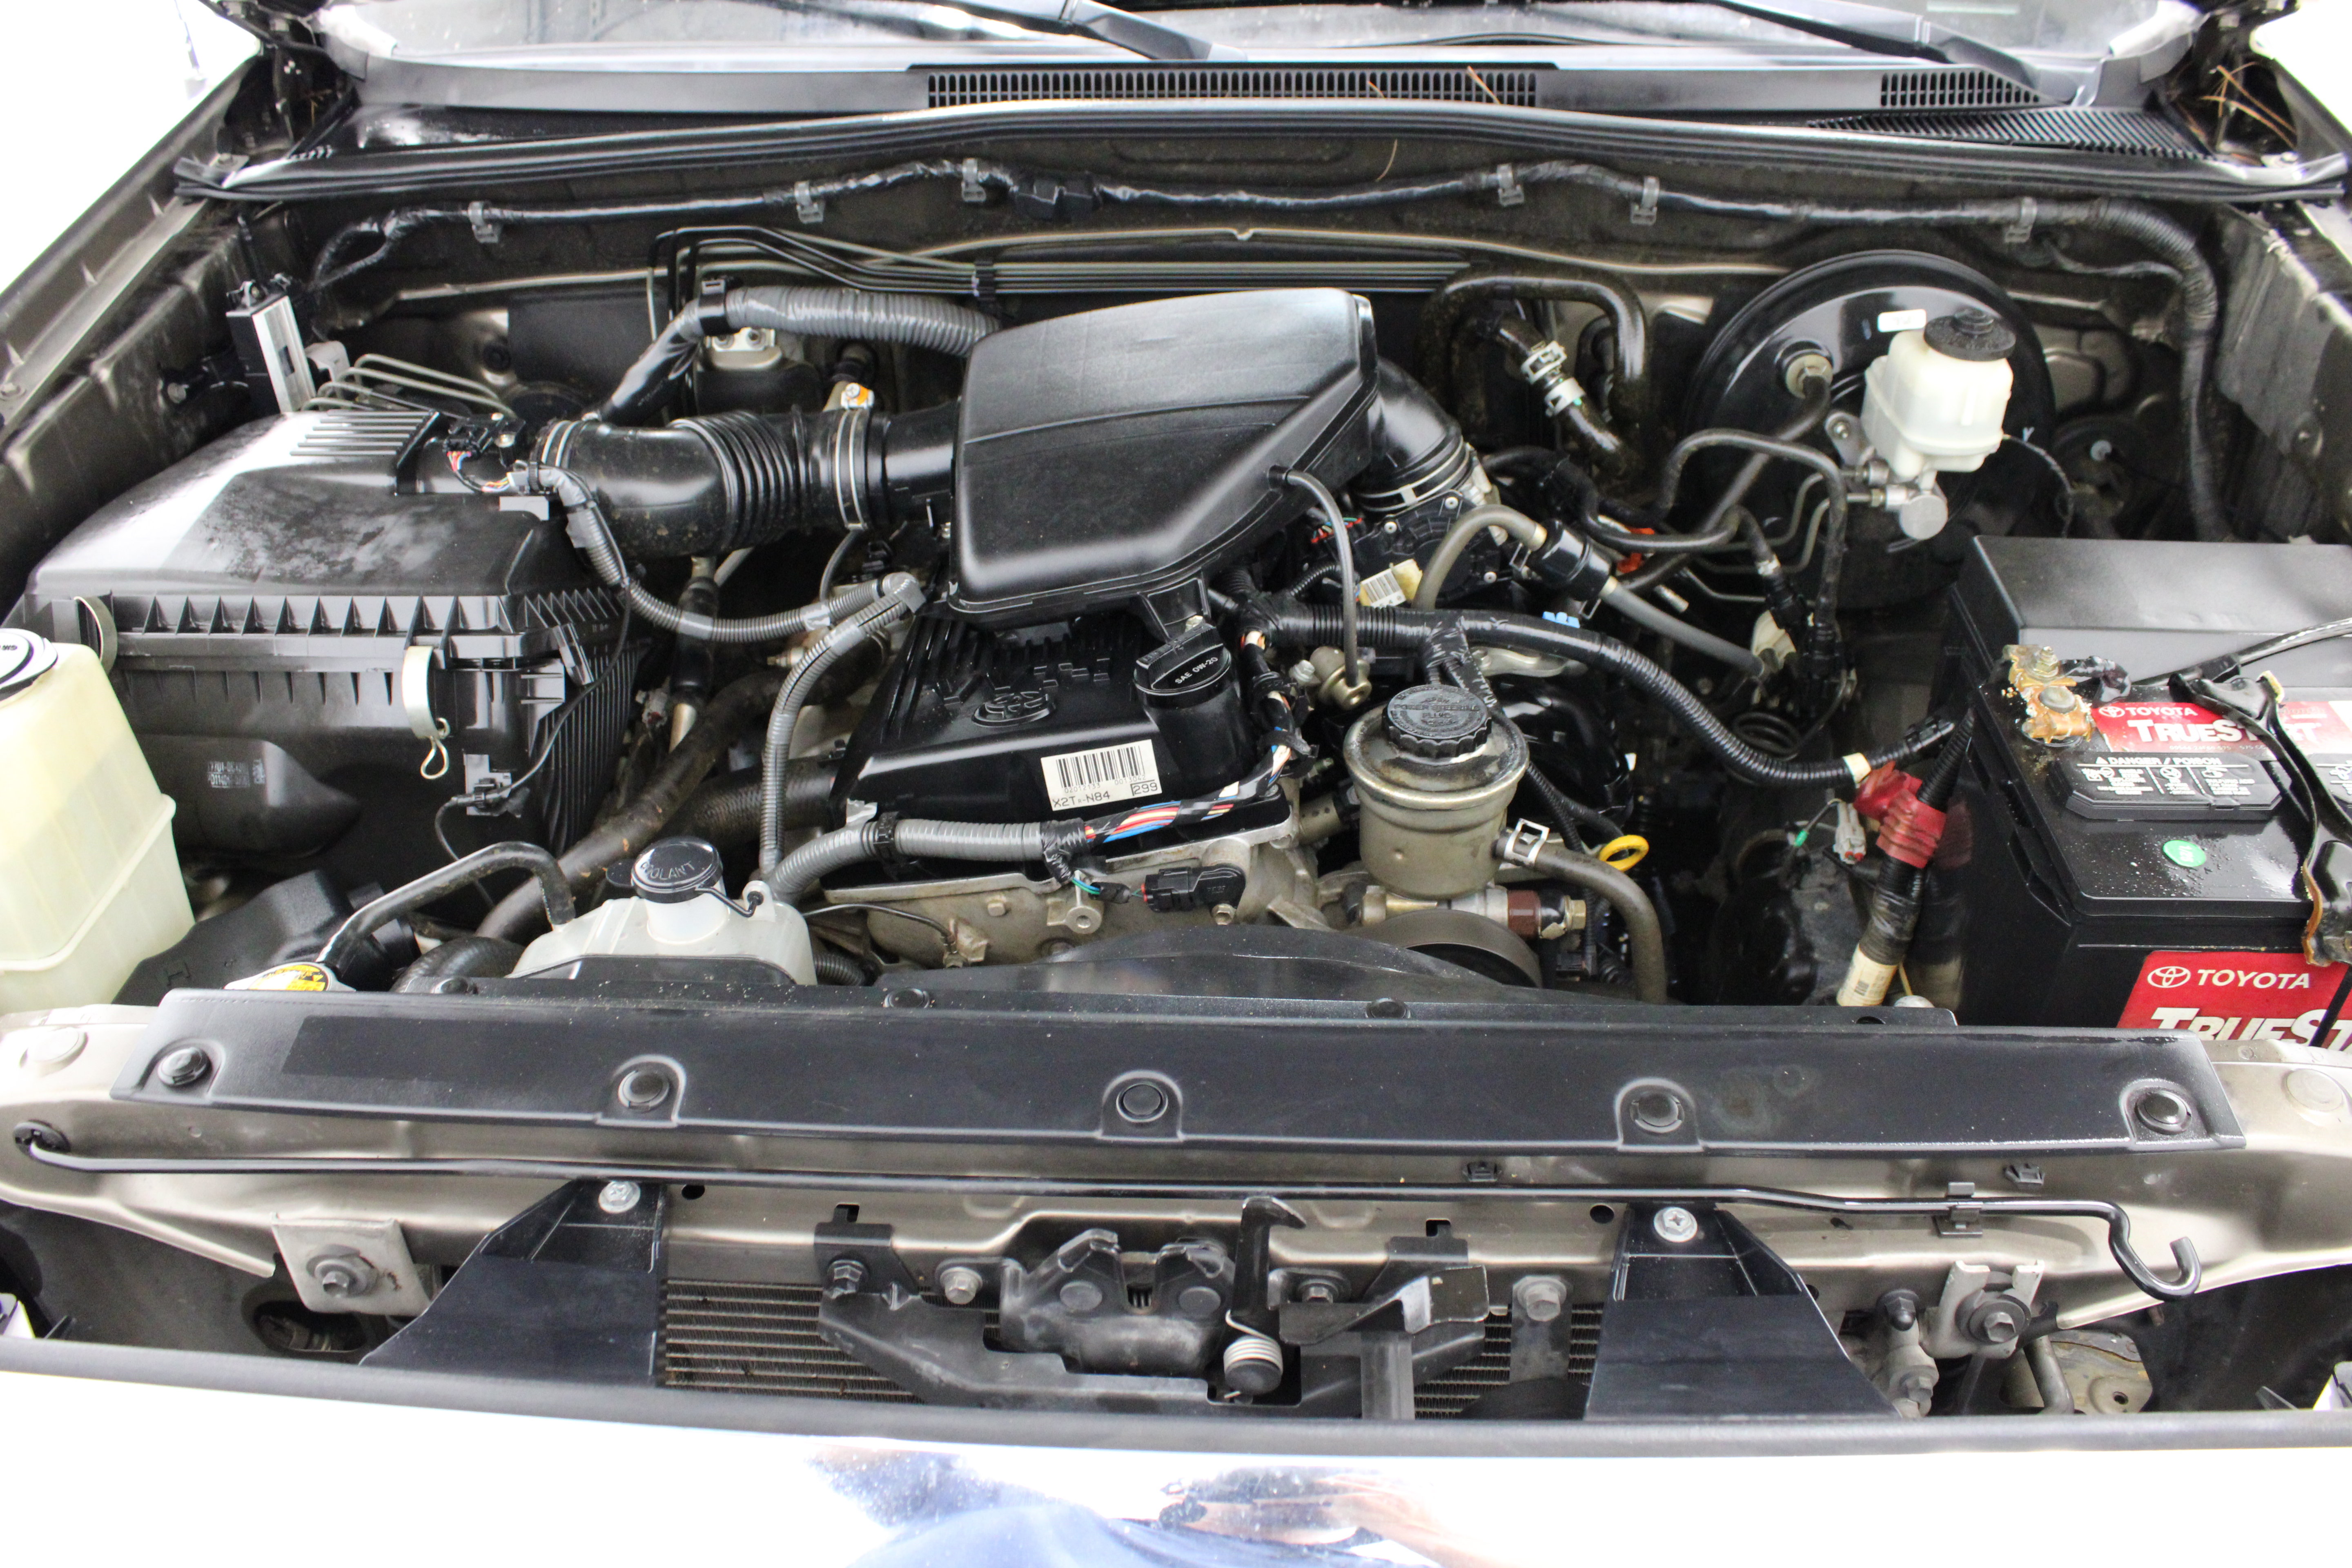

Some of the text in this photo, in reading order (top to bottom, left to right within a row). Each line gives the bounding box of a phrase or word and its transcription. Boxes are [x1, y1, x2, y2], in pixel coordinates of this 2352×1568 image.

[1175, 657, 1218, 684] SAE 0W-20
[2125, 707, 2198, 717] TOYOTA
[1065, 775, 1146, 794] 02012133 0013042
[1133, 782, 1158, 795] 299
[641, 860, 695, 880] COOLANT
[2196, 969, 2310, 989] TOYOTA
